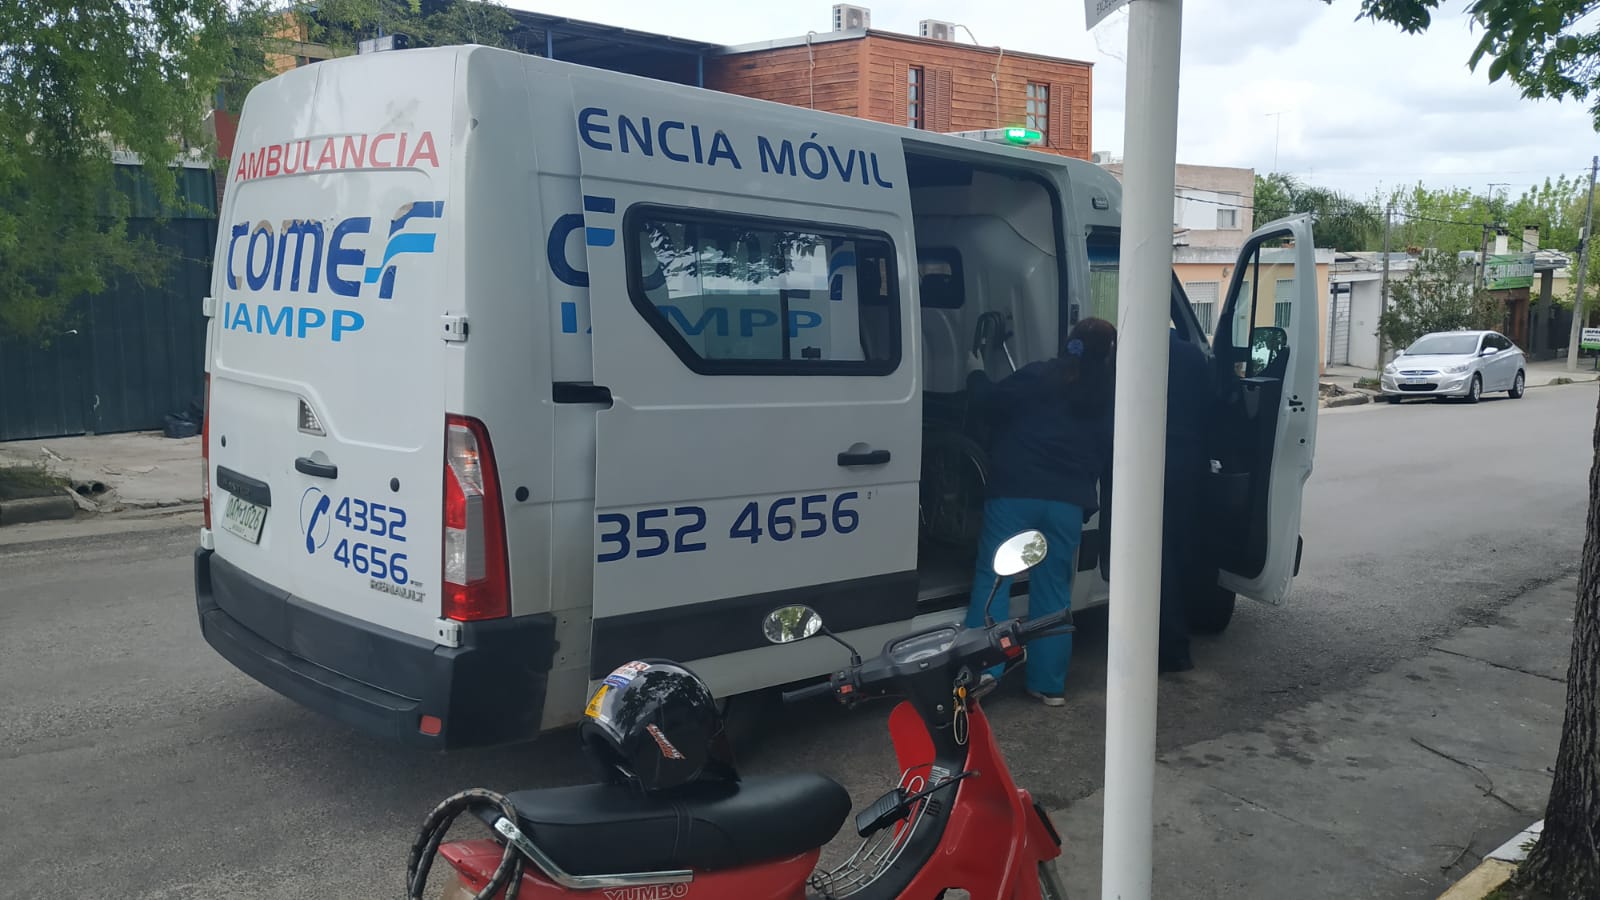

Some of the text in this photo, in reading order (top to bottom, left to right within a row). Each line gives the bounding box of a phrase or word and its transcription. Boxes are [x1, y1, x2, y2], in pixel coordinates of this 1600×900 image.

[234, 130, 440, 182] AMBULANCIA
[577, 106, 893, 189] ENCIA MÓVIL
[224, 301, 365, 342] IAMPP
[335, 496, 407, 542] 4352
[597, 491, 860, 563] 352 4656
[333, 538, 409, 584] 4656
[602, 882, 689, 900] YUMBO
